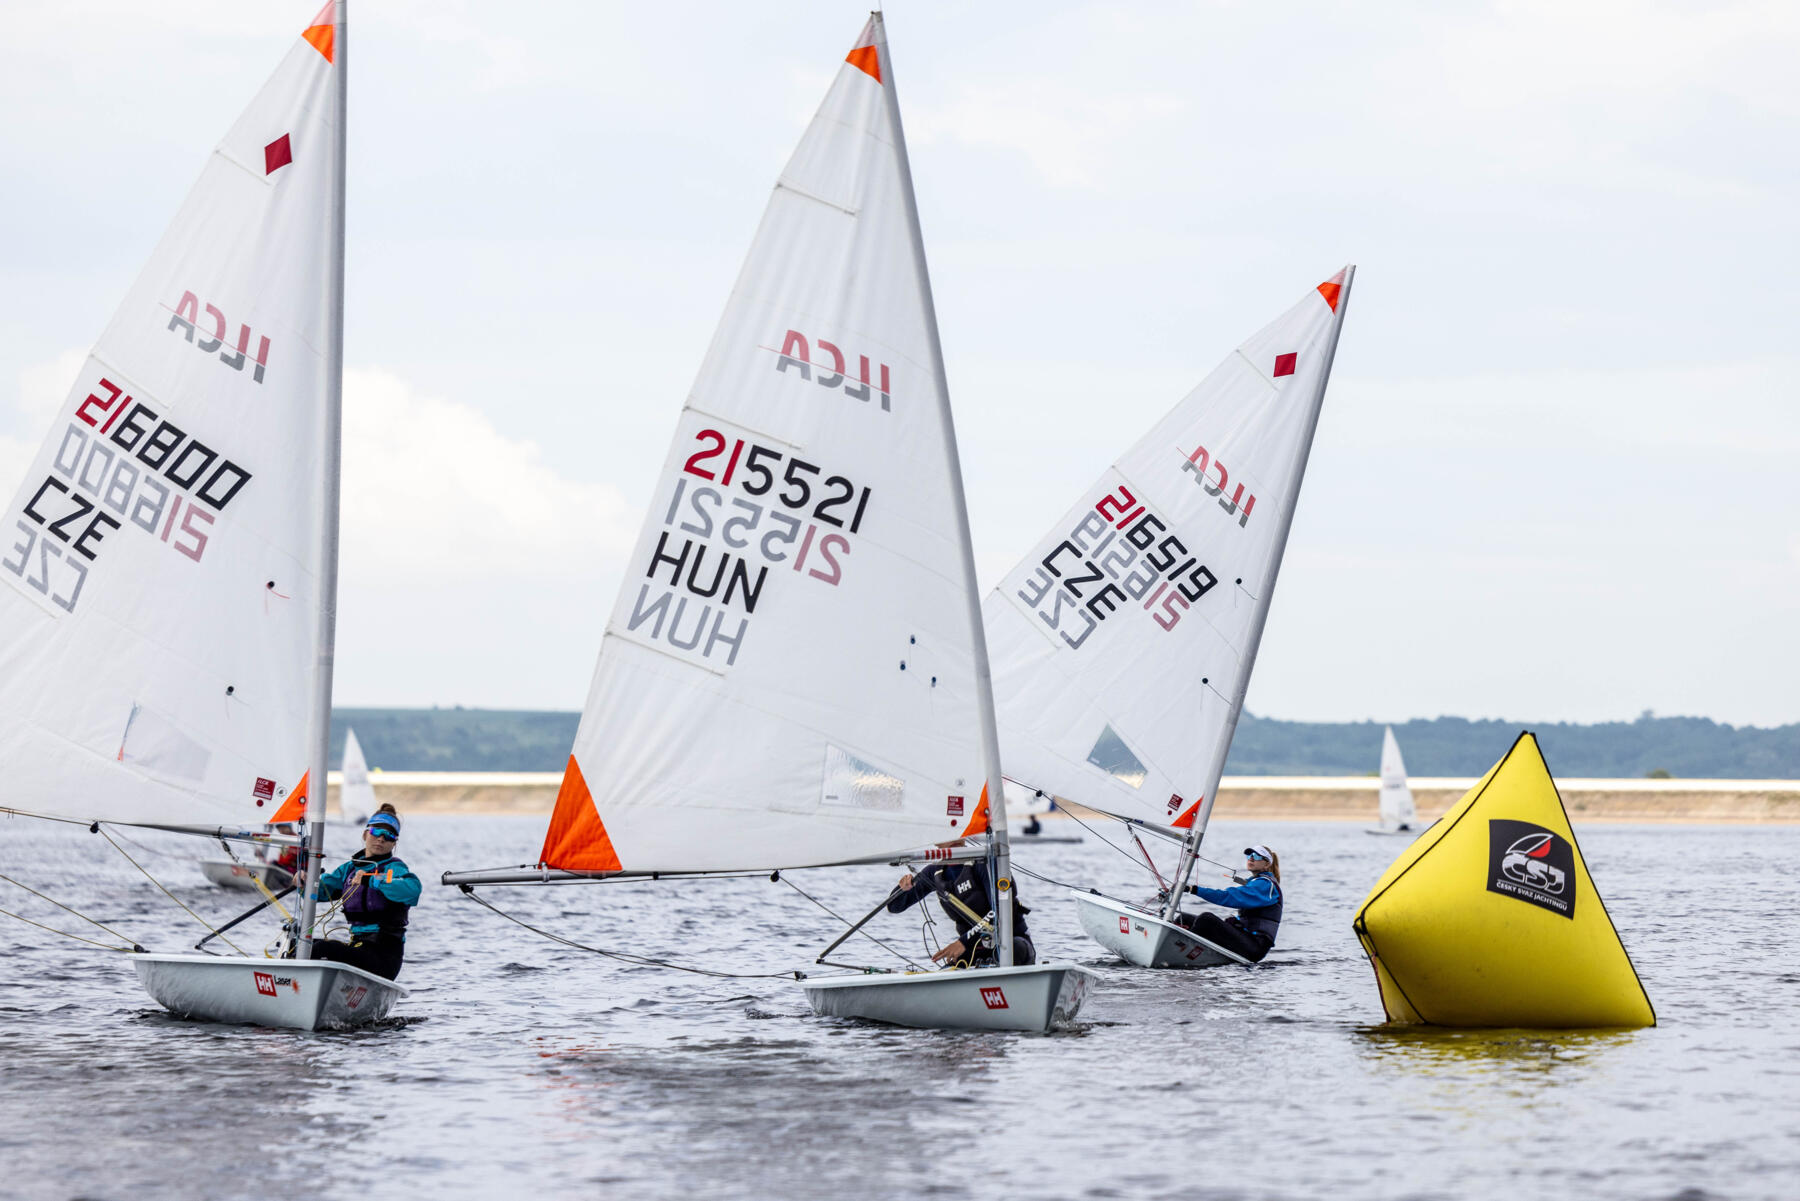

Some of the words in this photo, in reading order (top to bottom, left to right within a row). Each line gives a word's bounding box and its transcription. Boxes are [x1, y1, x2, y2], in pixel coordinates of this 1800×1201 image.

[75, 378, 253, 511] 216800
[683, 429, 871, 534] 215521
[23, 475, 122, 561] CZE
[1095, 485, 1218, 603] 216519
[646, 531, 768, 614] HUN
[1042, 540, 1128, 620] CZE
[957, 879, 973, 894] HH
[255, 974, 275, 994] HH
[982, 990, 1005, 1006] HH
